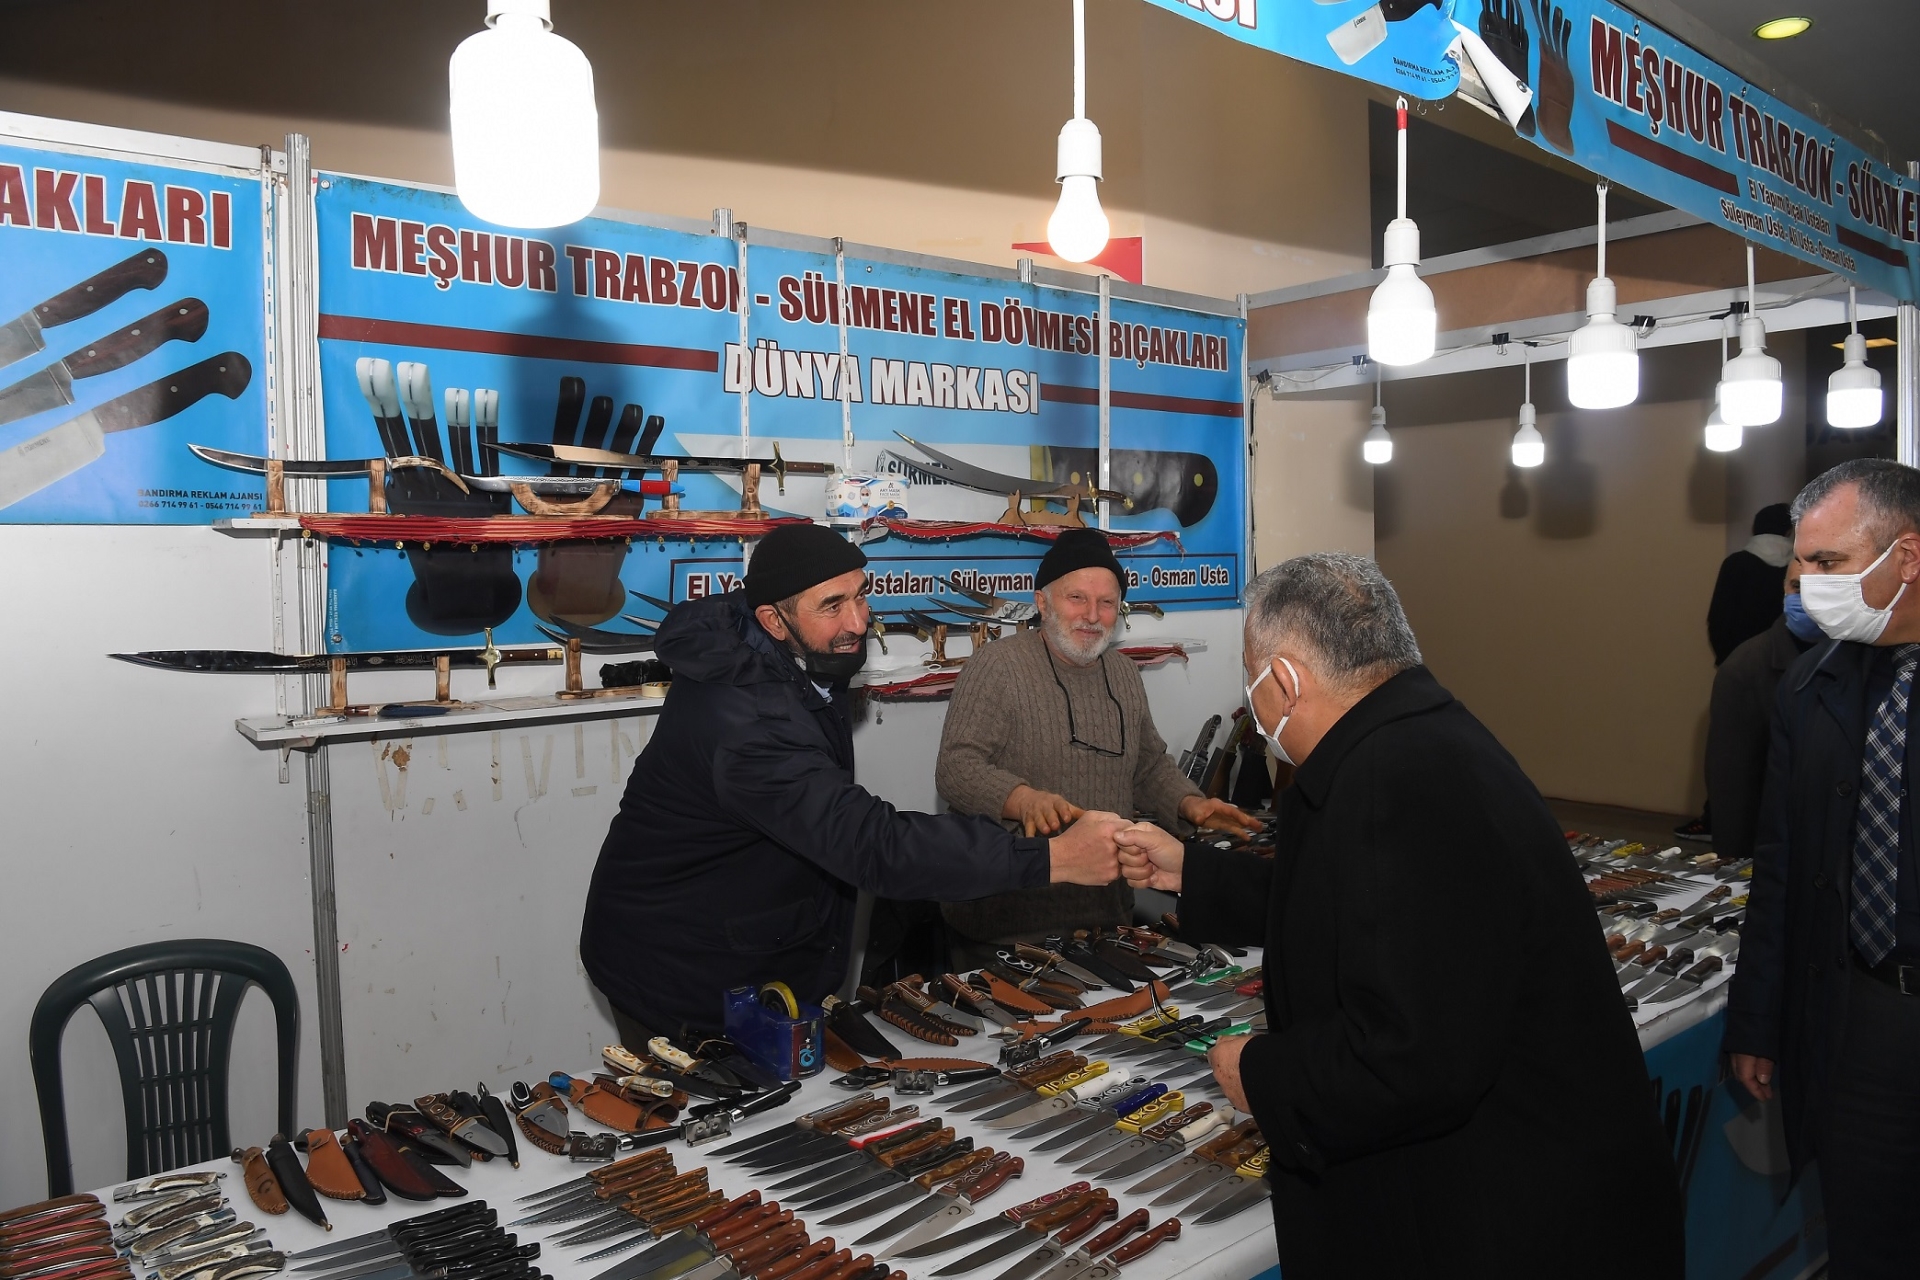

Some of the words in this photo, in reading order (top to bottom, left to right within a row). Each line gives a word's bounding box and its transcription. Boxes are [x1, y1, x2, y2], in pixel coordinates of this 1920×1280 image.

[1590, 14, 1725, 155] MEŞHUR
[1728, 92, 1836, 208] TRABZON
[1847, 157, 1920, 244] SÜRME
[0, 162, 232, 250] AKLARI
[1748, 177, 1758, 202] El
[1719, 197, 1765, 234] Süleyman
[1840, 249, 1857, 273] Usta
[350, 212, 557, 293] MEŞHUR
[778, 271, 937, 337] SÜRMENE
[942, 297, 975, 341] EL
[980, 297, 1100, 357] DÖVMESİ
[1109, 320, 1228, 372] BIÇAKLARI
[724, 338, 863, 403] DÜNYA
[870, 357, 1039, 415] MARKASI
[137, 489, 189, 498] BANDIRMA
[191, 491, 228, 500] REKLAM
[229, 492, 263, 501] AJANSI
[138, 500, 159, 508] 0266
[178, 501, 188, 509] 99
[205, 502, 224, 510] 0546
[253, 503, 262, 511] 61
[950, 568, 1035, 597] Süleyman
[1151, 565, 1197, 588] Osman
[1200, 564, 1230, 586] Usta
